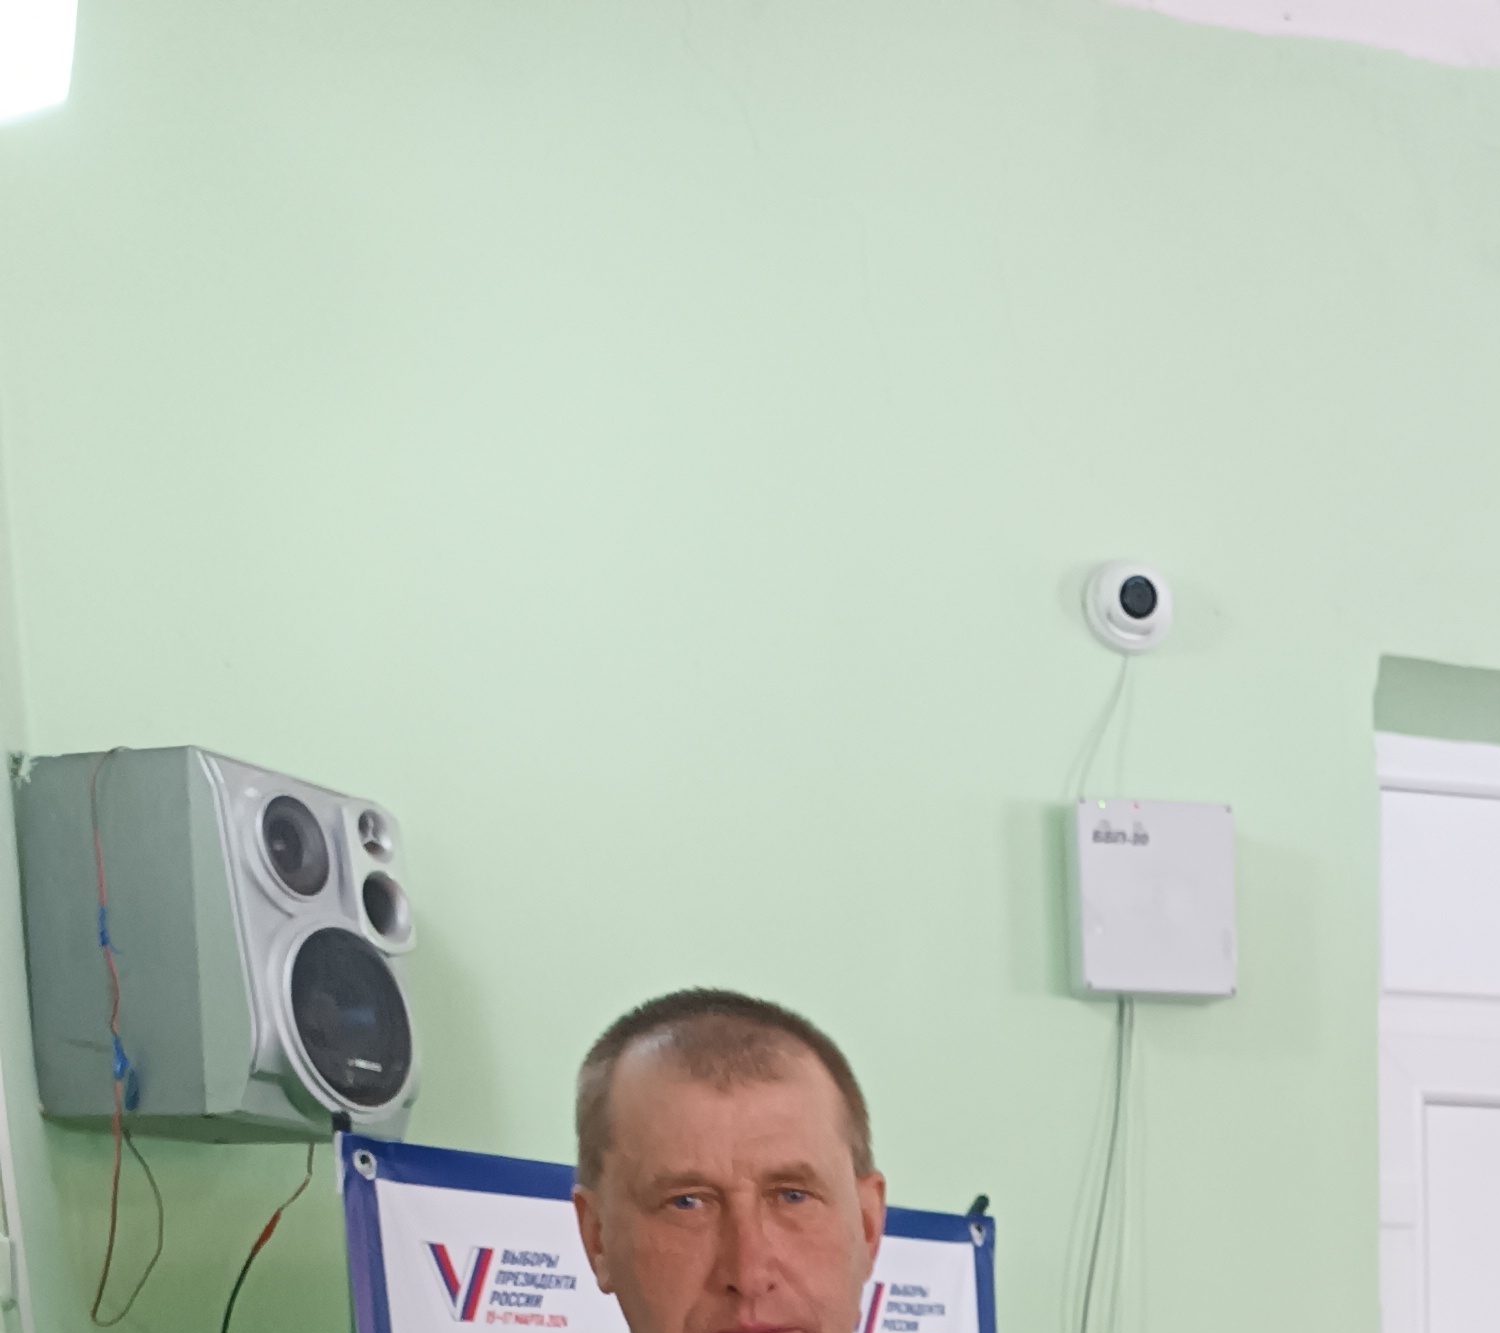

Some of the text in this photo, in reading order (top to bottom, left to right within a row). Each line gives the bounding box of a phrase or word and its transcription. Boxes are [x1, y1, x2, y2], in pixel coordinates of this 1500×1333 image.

[501, 1248, 560, 1269] ВЫБОРЫ
[495, 1270, 577, 1291] ПРЕЗИДЕНТА
[489, 1290, 544, 1309] РОССИИ
